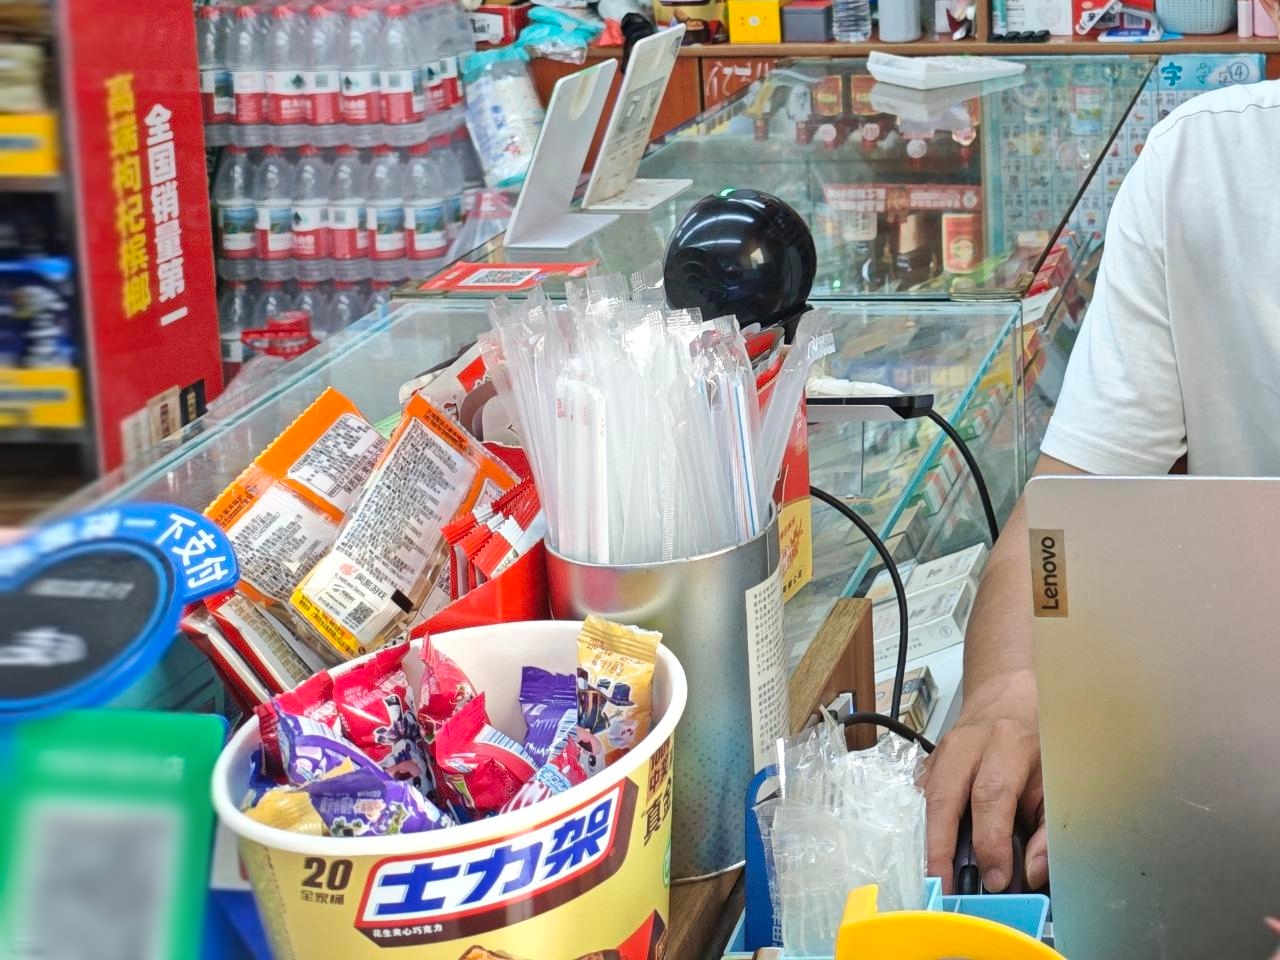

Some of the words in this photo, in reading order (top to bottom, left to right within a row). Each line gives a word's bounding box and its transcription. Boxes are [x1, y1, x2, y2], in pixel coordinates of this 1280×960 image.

[144, 103, 188, 327] 全国销量第一
[1041, 535, 1057, 611] Lenovo
[301, 857, 353, 891] 20
[374, 798, 612, 916] 士力架
[300, 890, 345, 905] 全家桶
[372, 924, 443, 938] 花生夹心巧克力
